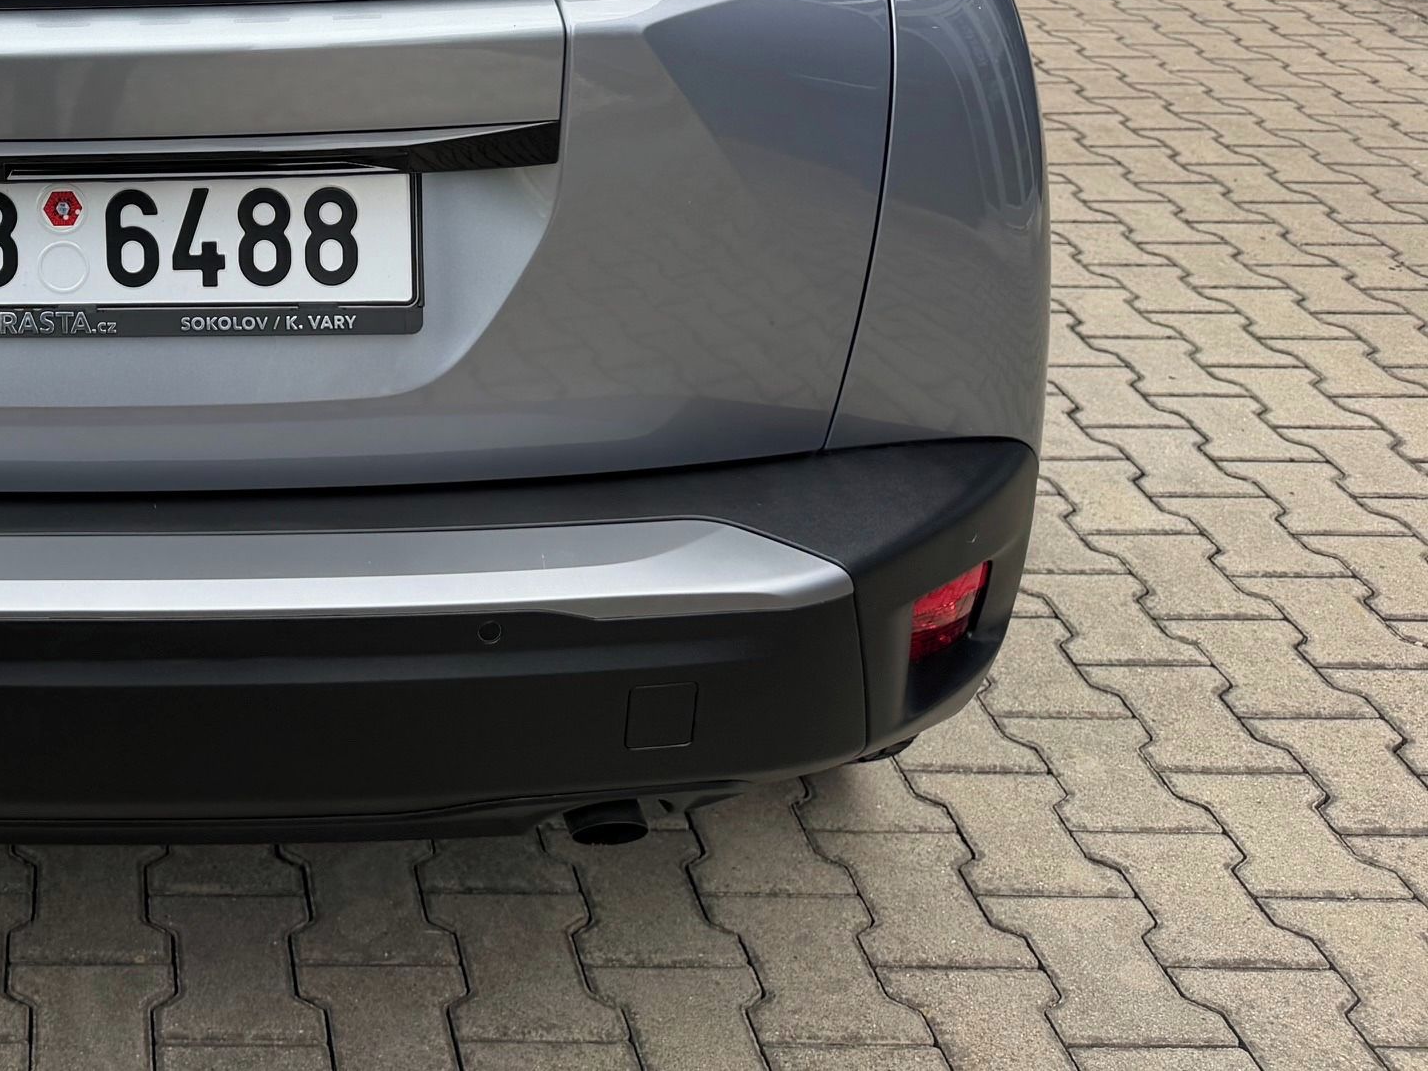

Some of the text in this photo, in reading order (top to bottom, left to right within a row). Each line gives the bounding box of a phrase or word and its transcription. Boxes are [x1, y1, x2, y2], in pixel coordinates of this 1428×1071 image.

[105, 186, 359, 287] 6488
[180, 316, 268, 331] SOKOLOV
[285, 315, 303, 330] K.
[307, 315, 357, 330] VARY
